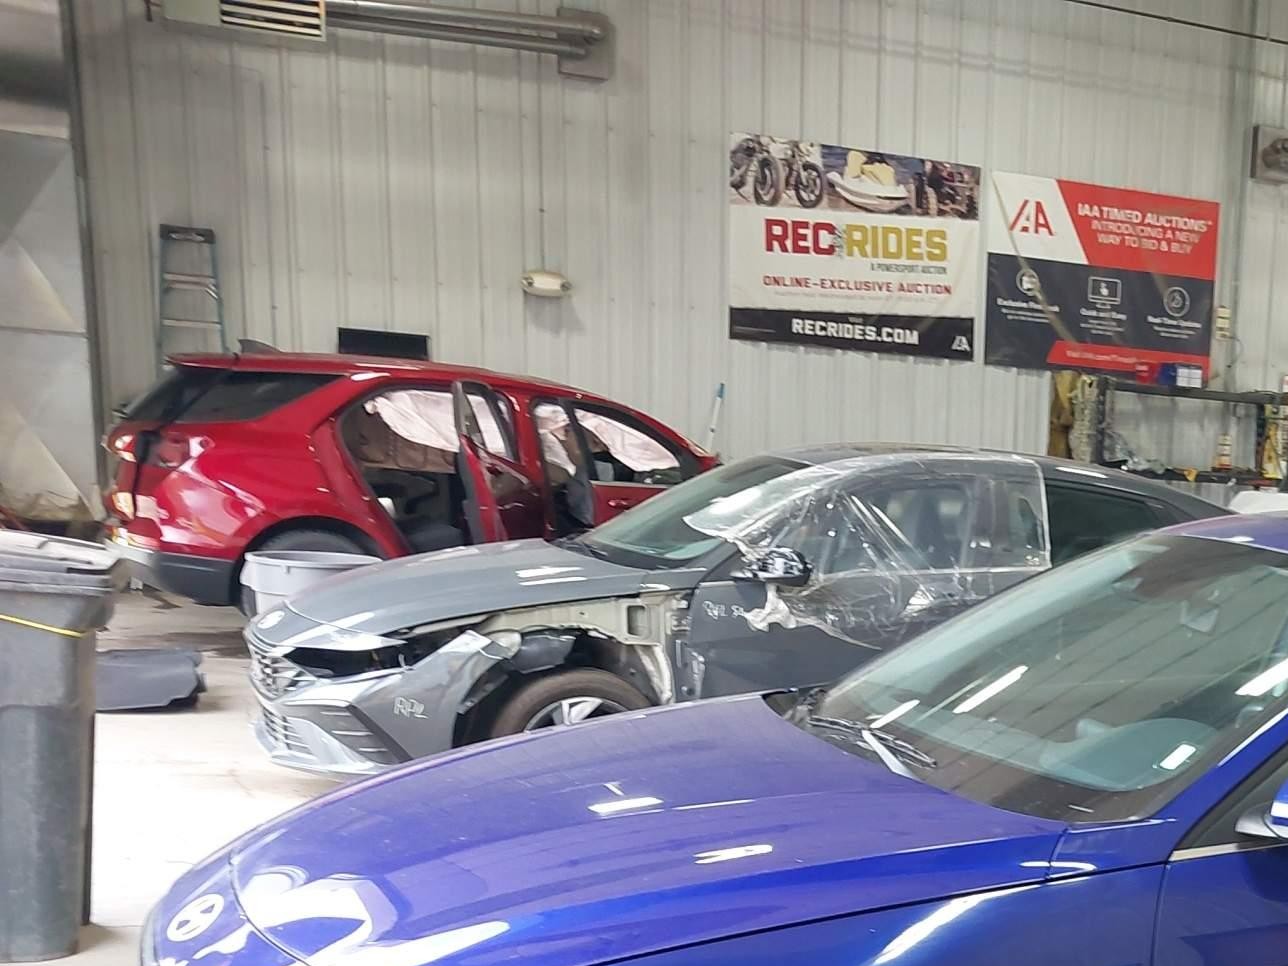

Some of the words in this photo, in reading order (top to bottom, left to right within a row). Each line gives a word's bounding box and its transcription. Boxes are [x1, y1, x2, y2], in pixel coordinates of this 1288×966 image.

[1077, 203, 1100, 218] IAA
[1100, 205, 1141, 224] TIMED
[763, 218, 836, 256] REC
[846, 222, 948, 262] RIDES
[1091, 220, 1163, 240] INTRODUCING
[1175, 230, 1201, 244] NEW
[1098, 233, 1121, 246] WAY
[1124, 236, 1139, 248] TO
[1140, 238, 1158, 250] BID
[1160, 240, 1169, 252] &
[1170, 242, 1193, 254] BUY
[763, 275, 893, 293] ONLINE-EXCLUSIVE
[897, 281, 952, 296] AUCTION
[791, 317, 919, 346] RECRIDES.COM
